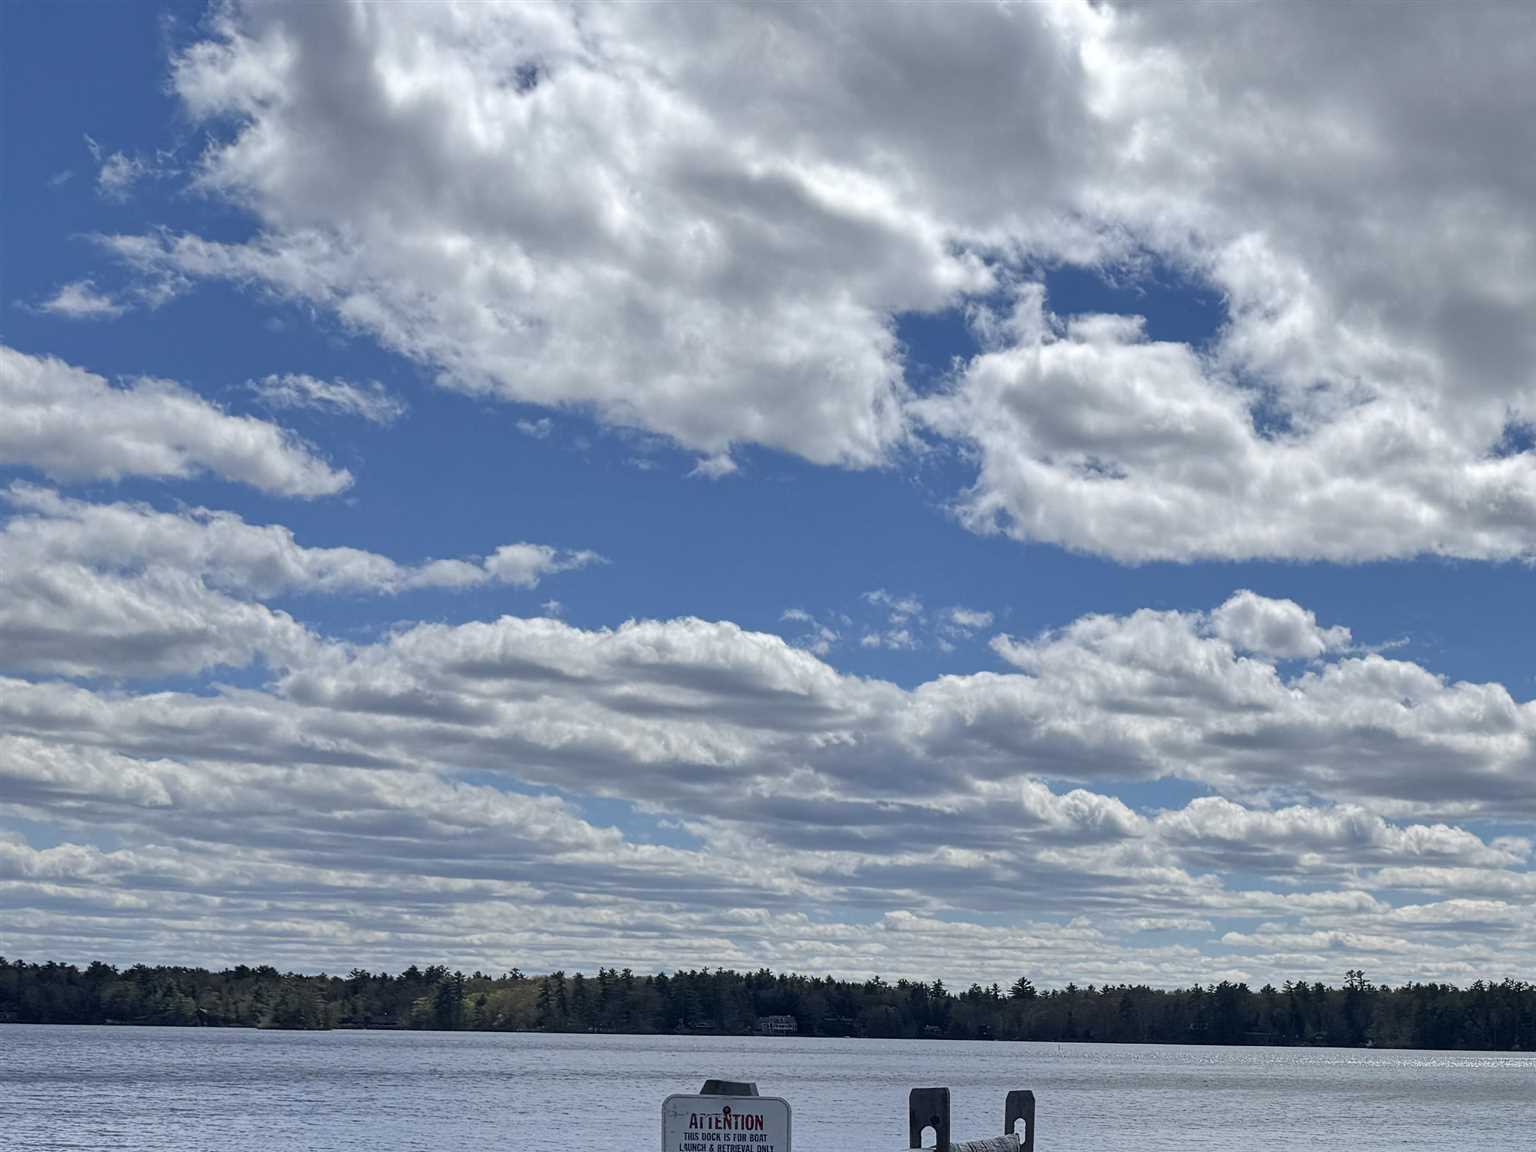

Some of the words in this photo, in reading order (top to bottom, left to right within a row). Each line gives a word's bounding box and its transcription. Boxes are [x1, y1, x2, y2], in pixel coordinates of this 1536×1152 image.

[689, 1113, 764, 1131] ATTENTION
[684, 1132, 699, 1141] THIS
[701, 1132, 721, 1141] DOCK
[724, 1133, 730, 1142] IS
[733, 1133, 747, 1142] FOR
[750, 1134, 768, 1142] BOAT
[680, 1143, 706, 1152] LAUNCH
[709, 1144, 714, 1152] &
[717, 1144, 754, 1152] RETRIEVAL
[757, 1145, 774, 1152] ONLY
